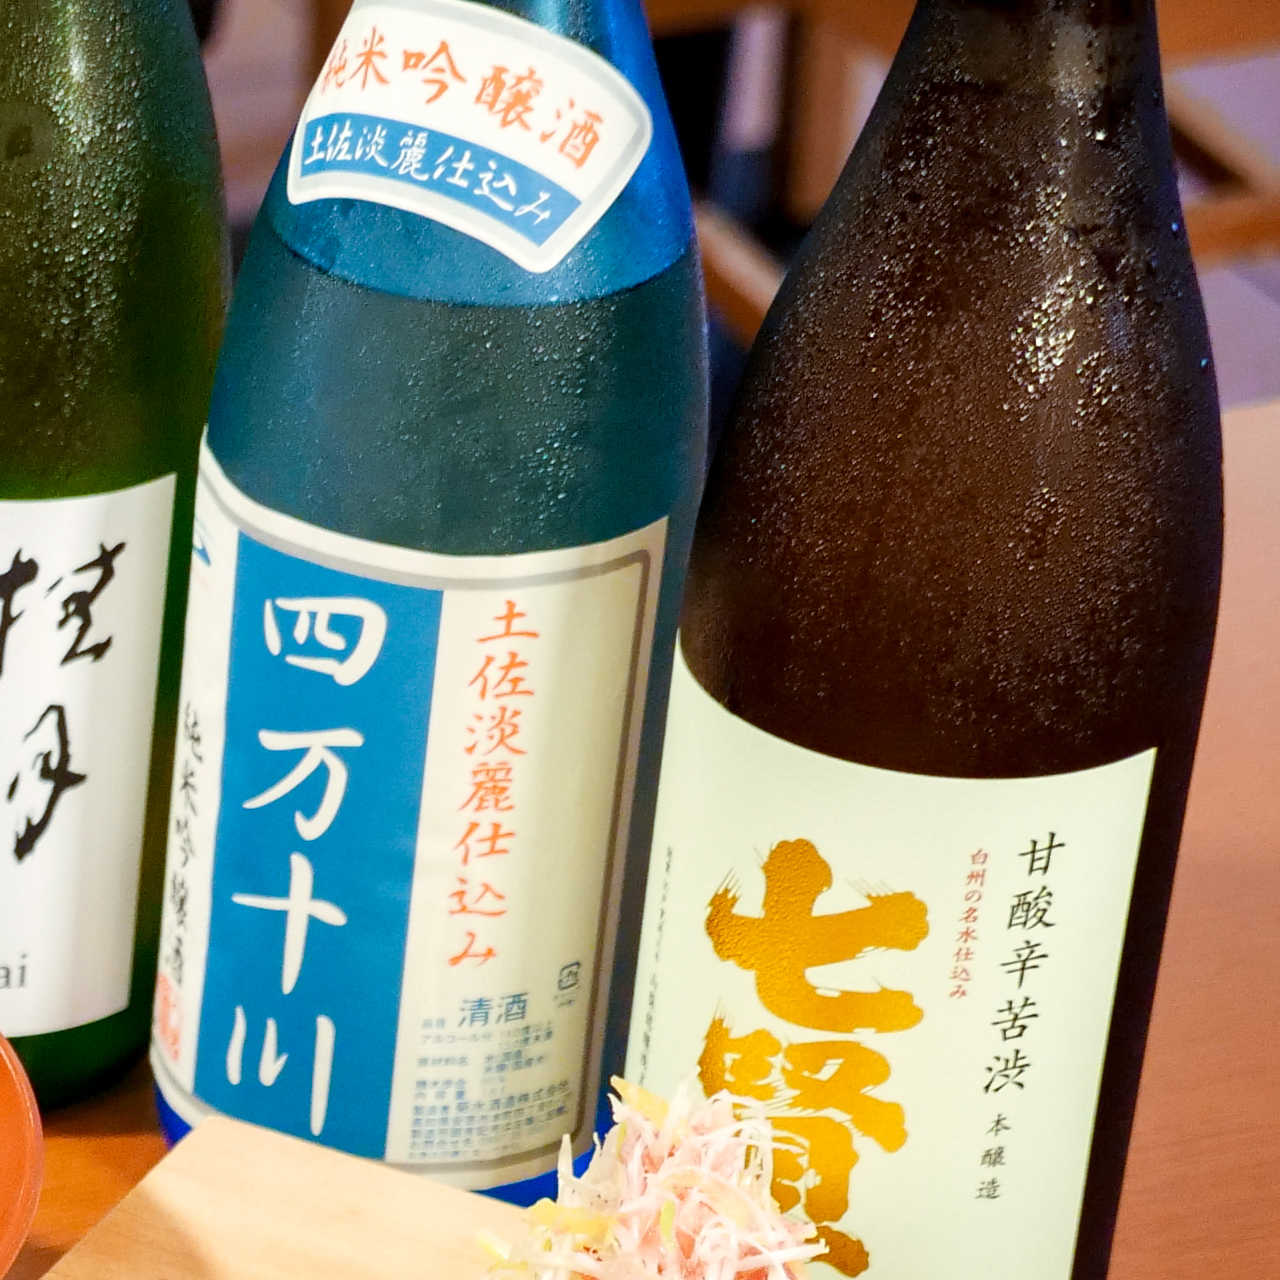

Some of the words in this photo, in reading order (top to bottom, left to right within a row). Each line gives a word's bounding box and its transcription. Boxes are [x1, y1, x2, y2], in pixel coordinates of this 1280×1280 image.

[321, 26, 603, 169] 純米吟醸酒
[304, 119, 551, 226] 土佐淡麗仕込み
[449, 600, 539, 967] 土佐淡麗仕込み
[226, 596, 387, 1136] 四万十川
[949, 848, 989, 999] 白州の名水仕込み
[458, 991, 529, 1028] 清酒
[983, 831, 1066, 1094] 甘酸辛苦渋
[975, 1112, 1012, 1201] 本醸造
